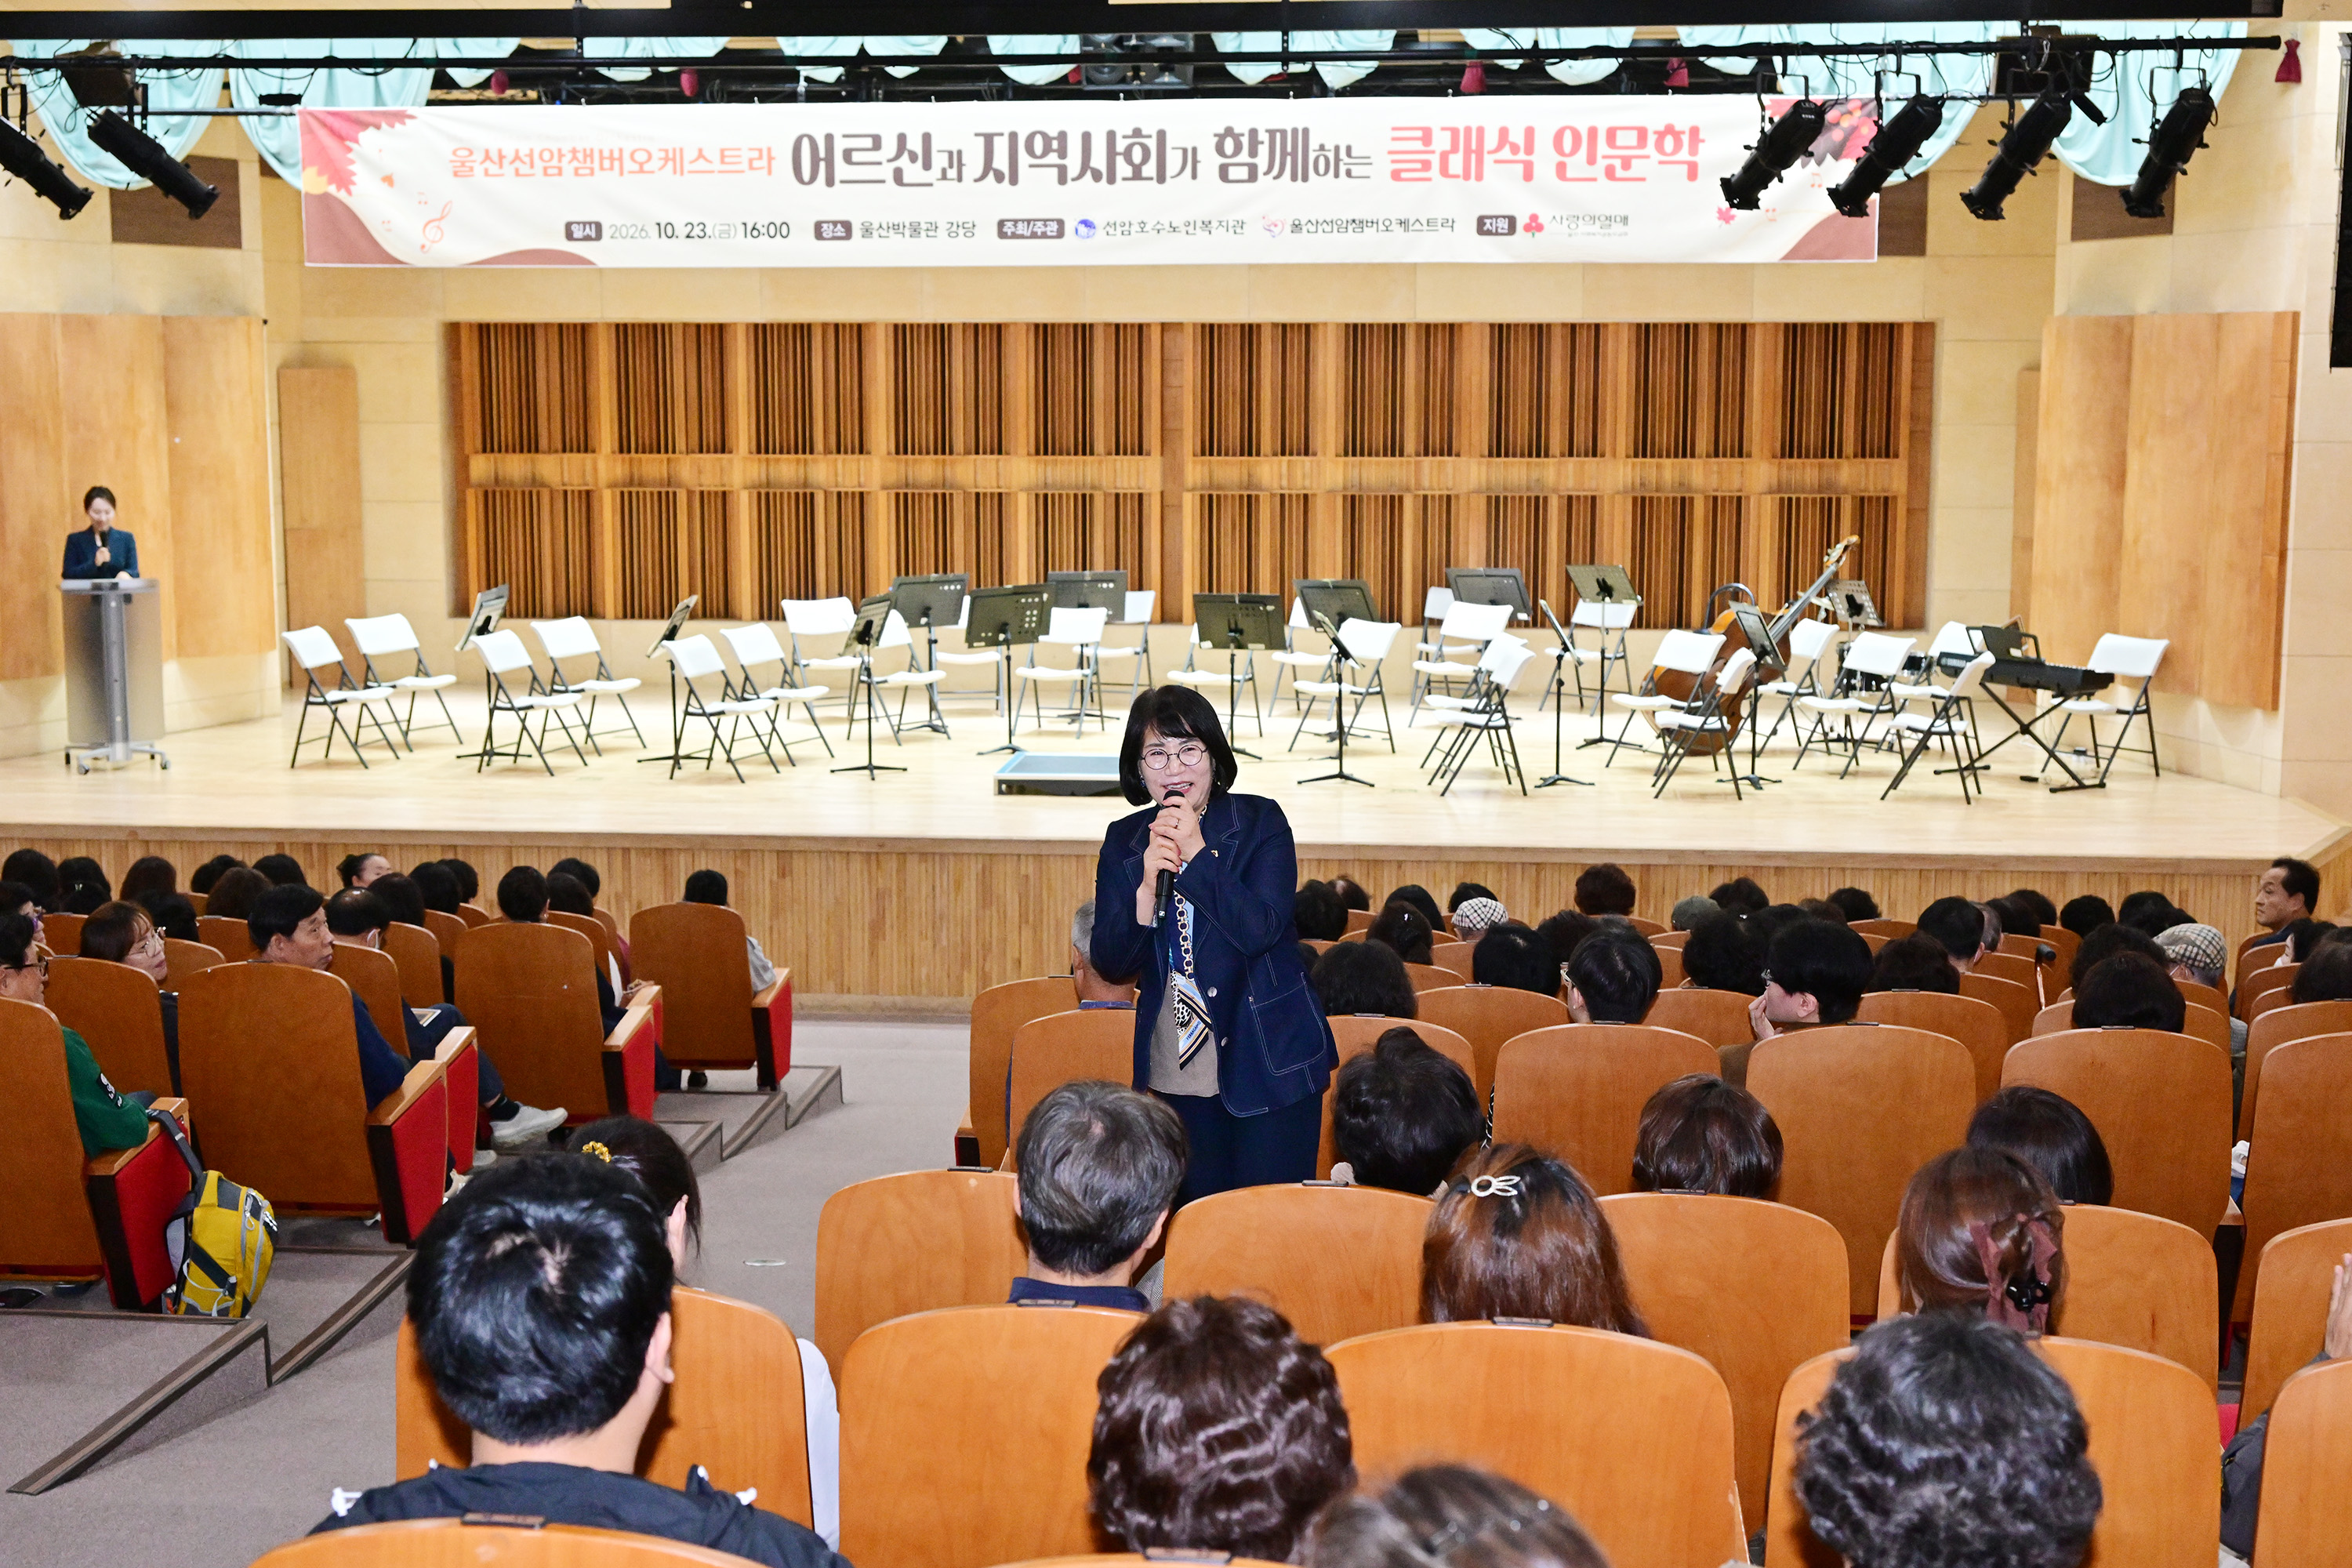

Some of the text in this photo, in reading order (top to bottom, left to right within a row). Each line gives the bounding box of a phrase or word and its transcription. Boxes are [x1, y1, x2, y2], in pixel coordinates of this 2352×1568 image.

[449, 123, 1706, 188] 울산선암챔버오케스트라 어르신과 지역사회가 함께하는 클래식 인문학
[820, 220, 976, 239] 장소 울산박물관 강당
[1002, 219, 1247, 237] 주최/주관 선암호수노인복지관
[1290, 218, 1456, 234] 울산선암챔버오케스트라
[1483, 217, 1509, 234] 지원
[1550, 212, 1629, 230] 사랑의열매
[570, 223, 596, 239] 일시
[608, 223, 652, 240] 2026.
[655, 221, 679, 239] 10.
[741, 221, 790, 239] 16:00
